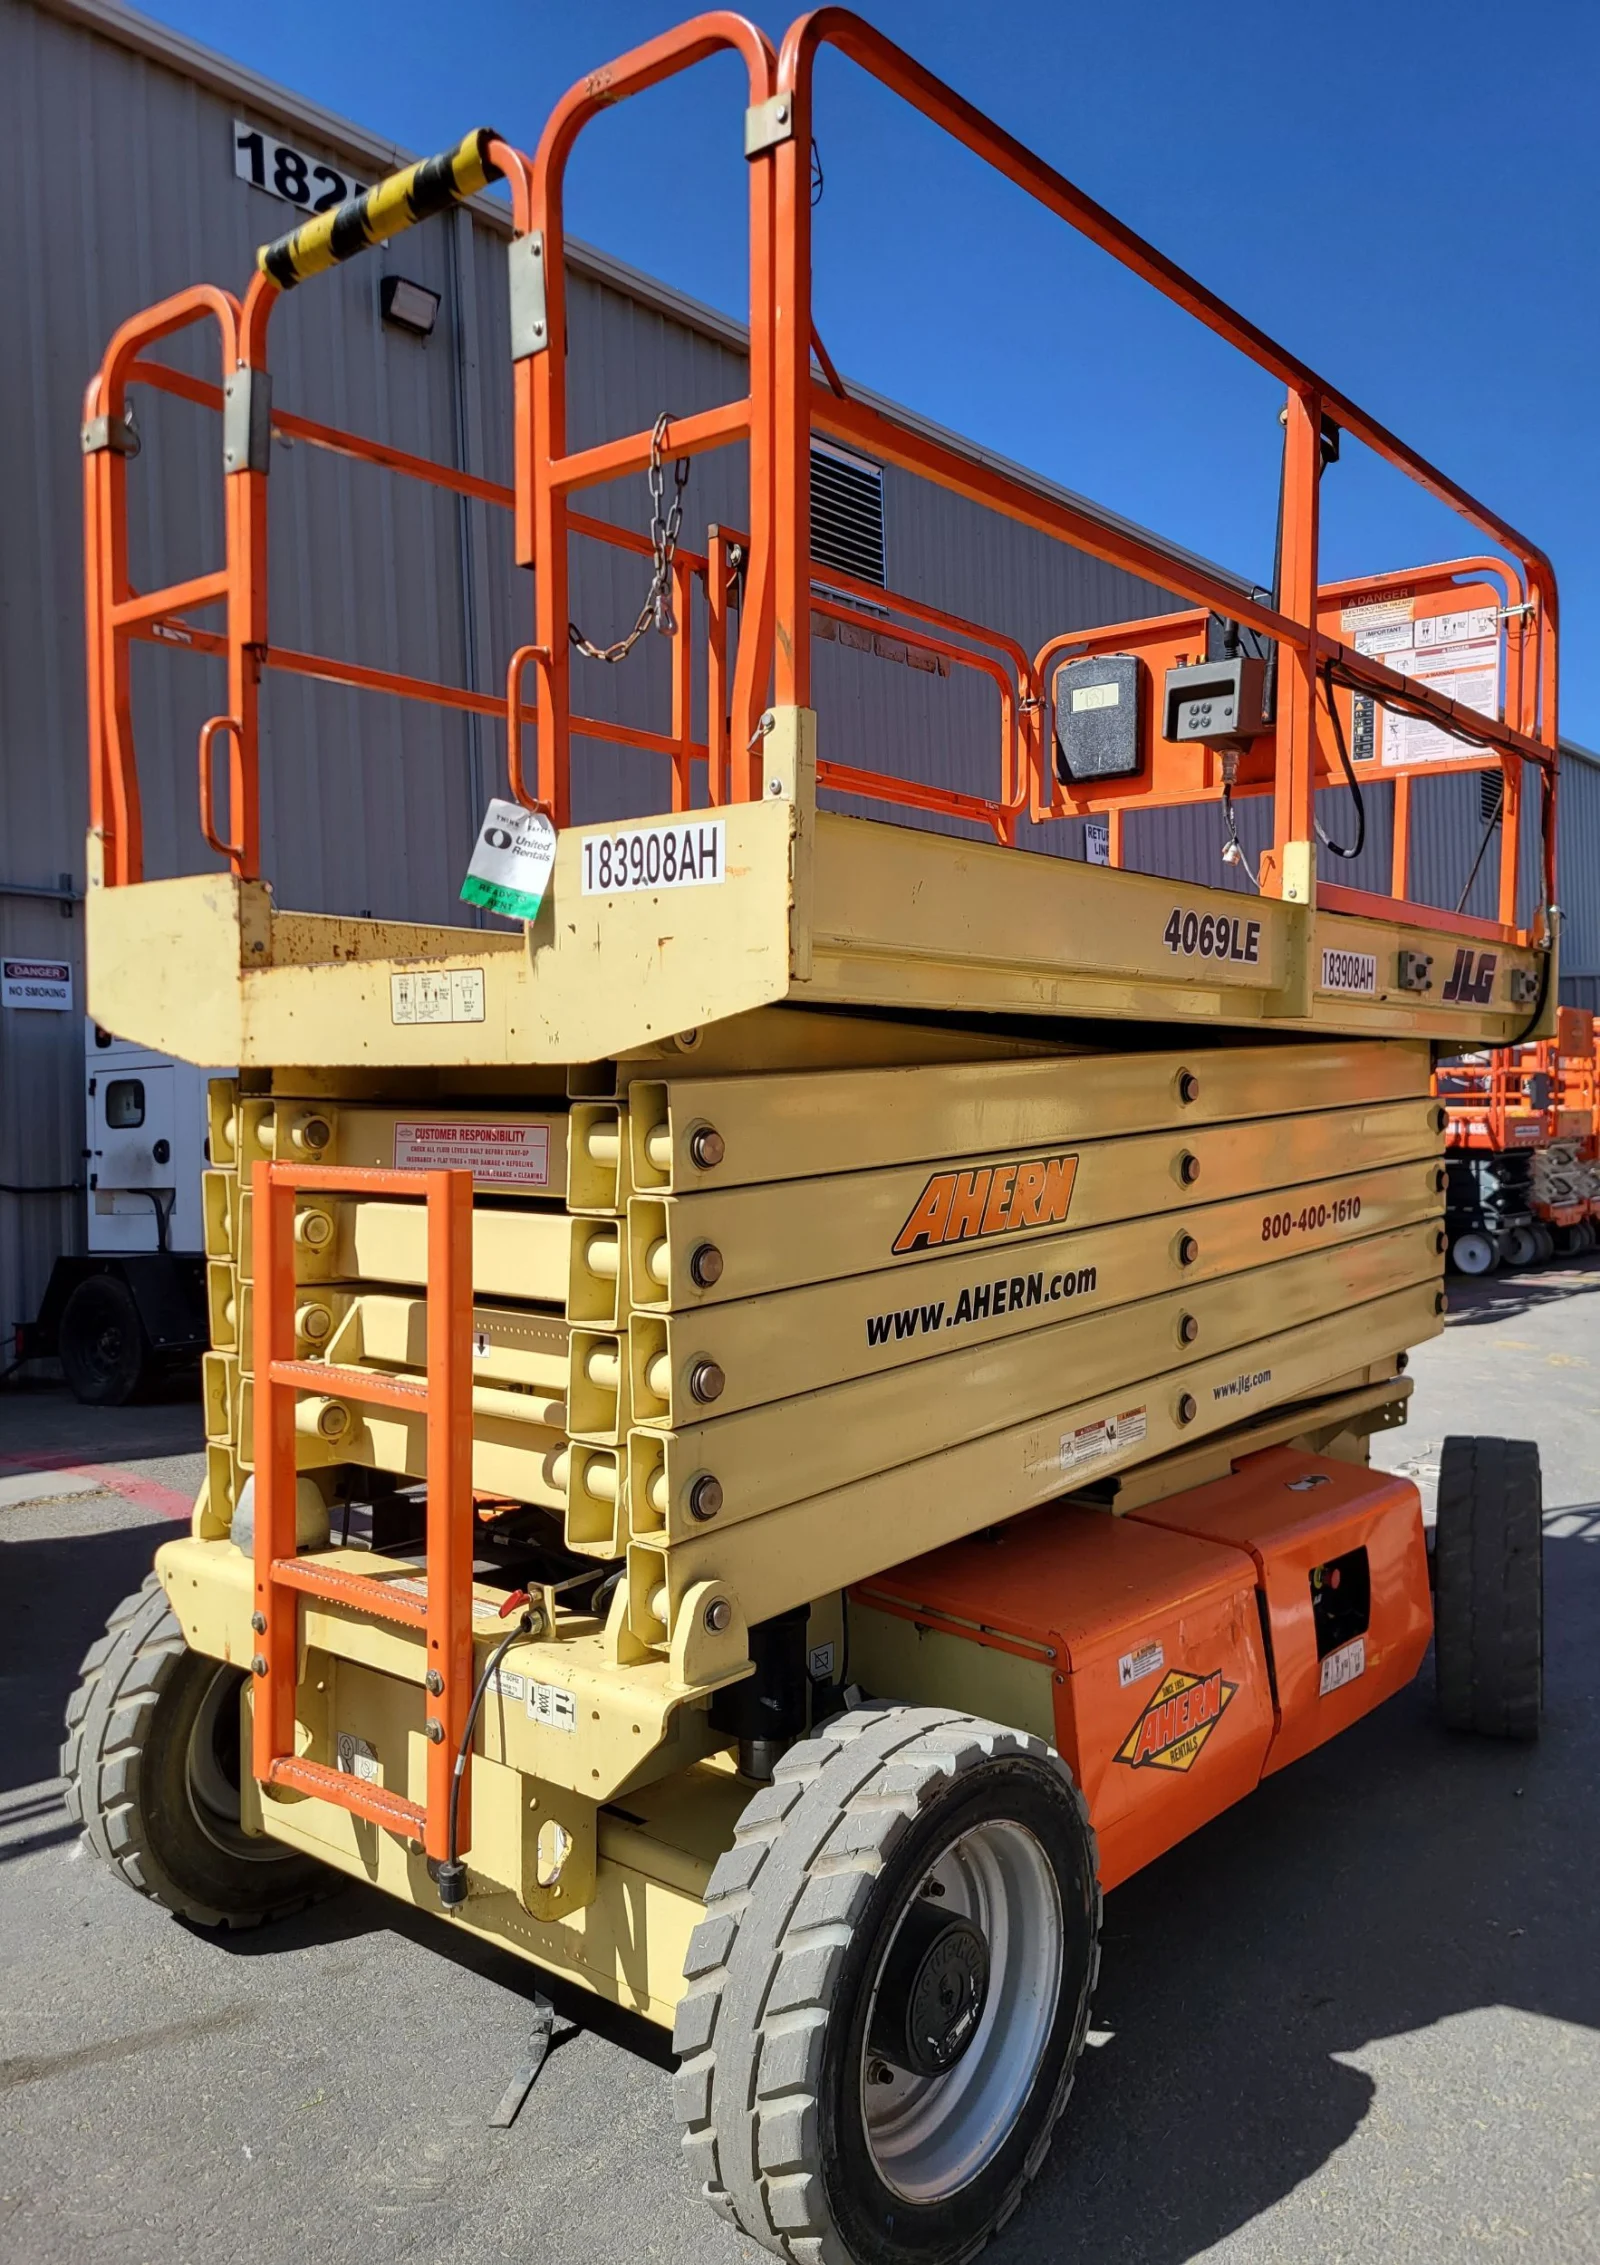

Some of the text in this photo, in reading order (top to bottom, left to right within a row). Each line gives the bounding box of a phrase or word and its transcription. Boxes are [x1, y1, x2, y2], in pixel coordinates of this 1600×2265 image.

[237, 132, 367, 212] 182
[1357, 588, 1409, 606] DANGER
[1365, 626, 1402, 637] IMPORTANT
[511, 846, 551, 862] Rentals
[514, 835, 553, 851] United
[584, 827, 718, 889] 183908AH
[478, 883, 512, 898] READY
[1164, 908, 1261, 962] 4069LE
[14, 965, 60, 977] DANGER
[1322, 951, 1374, 991] 183908AH
[1442, 949, 1498, 1004] JLG
[9, 986, 66, 998] NO SMOKING
[415, 1128, 526, 1142] CUSTOMER RESPONSIBILITY
[477, 1170, 512, 1178] MAINTENANCE
[517, 1172, 544, 1180] CLEANING
[893, 1156, 1079, 1252] AHERN
[1261, 1196, 1361, 1241] 800-400-1610
[867, 1267, 1097, 1346] www.AHERN.com
[1213, 1369, 1272, 1400] www.jlg.com
[1132, 1673, 1221, 1765] AHERN
[1170, 1736, 1198, 1764] RENTALS
